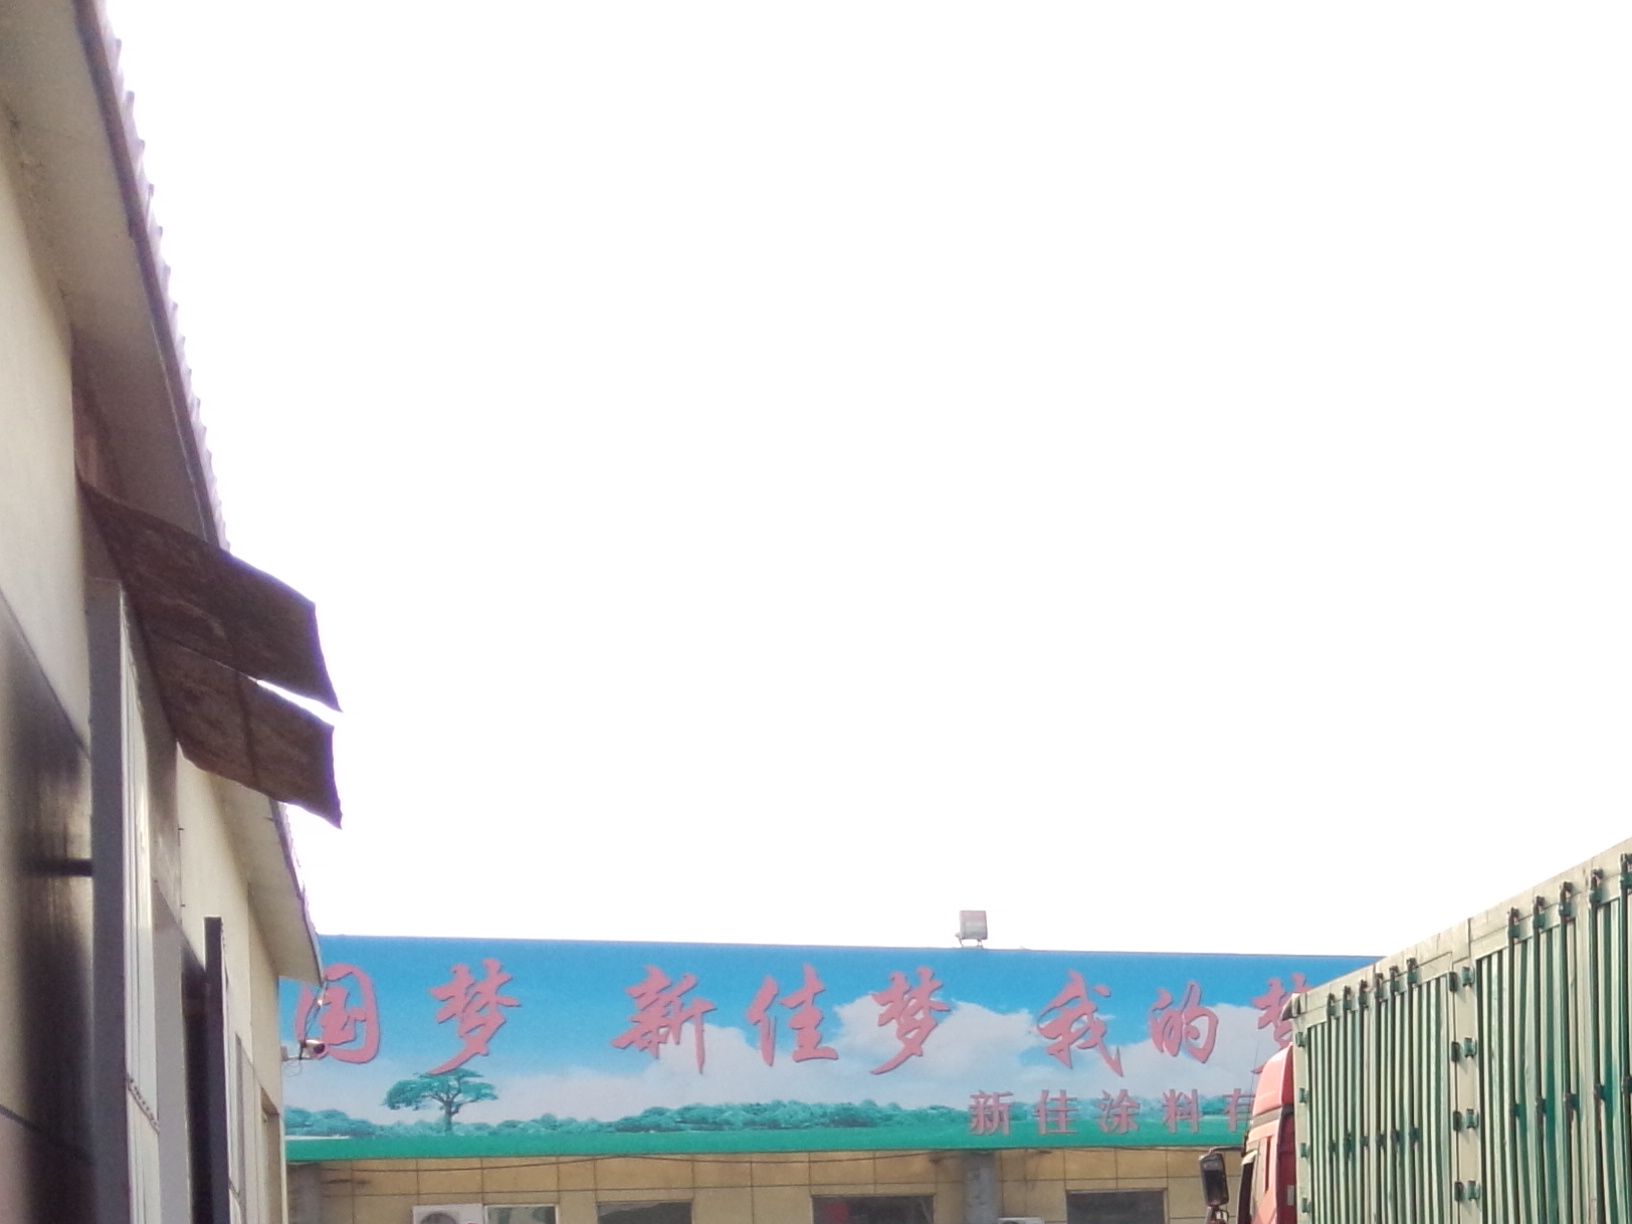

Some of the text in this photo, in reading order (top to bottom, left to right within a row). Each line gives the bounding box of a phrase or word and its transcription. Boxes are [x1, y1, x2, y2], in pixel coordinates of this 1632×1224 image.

[295, 958, 521, 1075] 国梦
[612, 962, 951, 1076] 新佳梦
